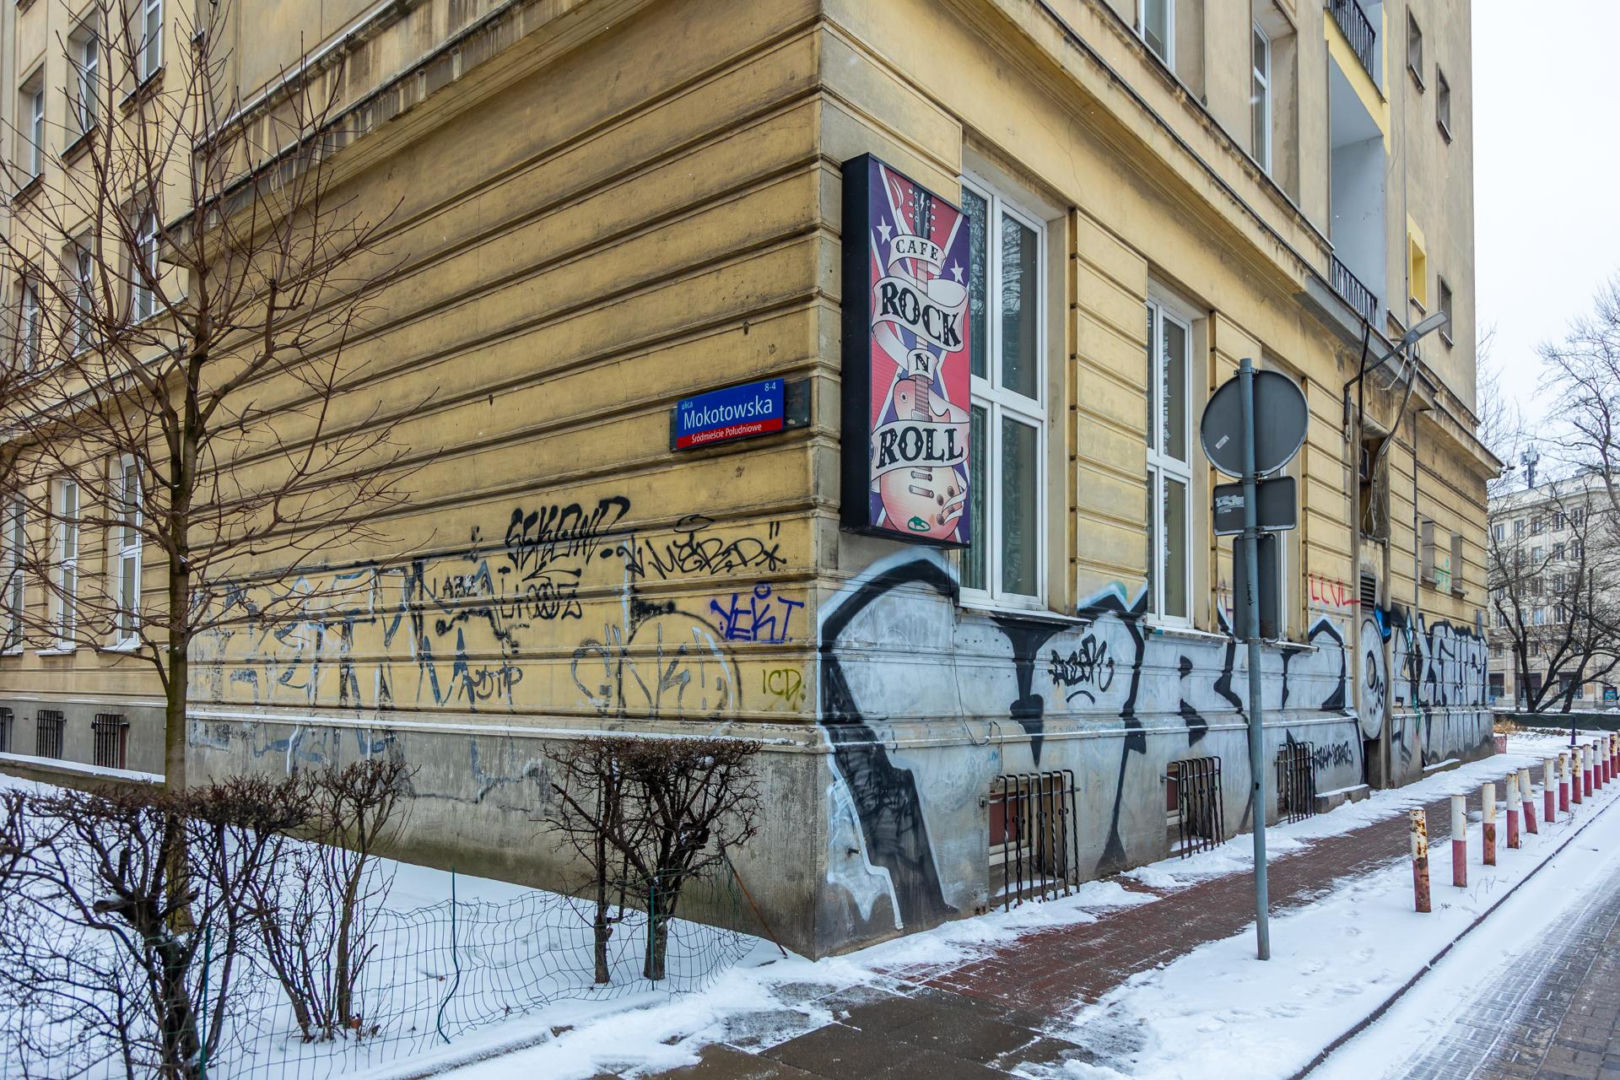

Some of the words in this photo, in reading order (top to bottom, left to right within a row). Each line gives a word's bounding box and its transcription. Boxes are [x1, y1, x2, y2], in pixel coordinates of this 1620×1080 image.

[895, 239, 939, 261] CAFE
[880, 281, 961, 347] ROCK
[914, 352, 930, 373] N
[764, 382, 777, 392] 8-4
[683, 395, 773, 430] Mokotowska
[725, 423, 762, 437] Południowe
[876, 426, 964, 469] ROLL
